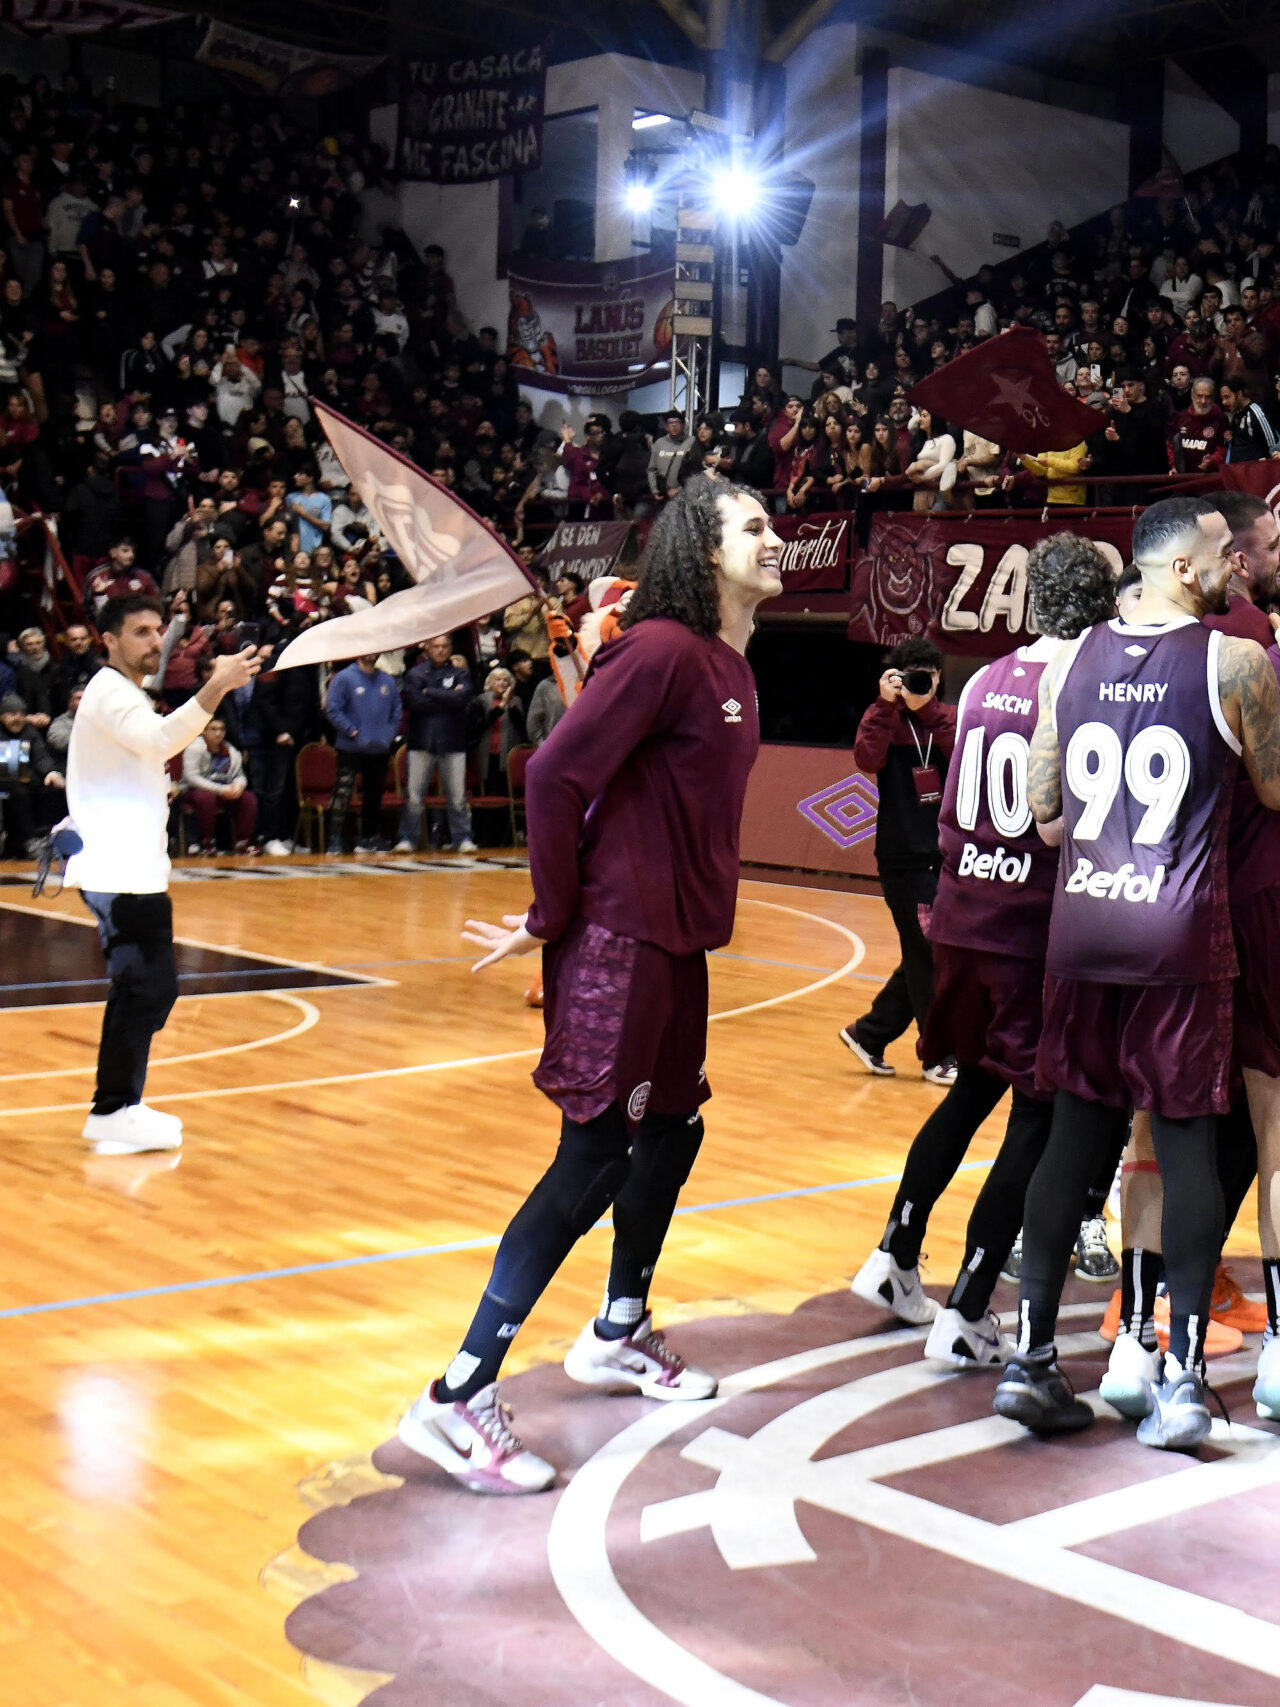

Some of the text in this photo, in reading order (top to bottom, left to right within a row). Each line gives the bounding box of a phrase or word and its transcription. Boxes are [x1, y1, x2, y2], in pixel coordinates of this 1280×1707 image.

[408, 45, 541, 84] TU CASACA
[428, 89, 510, 133] GRANATE
[402, 123, 538, 178] ME FASCINA
[574, 289, 645, 334] LANÚS
[575, 334, 643, 362] BASQUET
[982, 691, 1033, 716] SACCHI
[1099, 682, 1169, 703] HENRY
[956, 726, 1033, 838] 10
[1066, 721, 1191, 845] 99
[958, 843, 1032, 883] Befol
[1065, 857, 1165, 904] Befol
